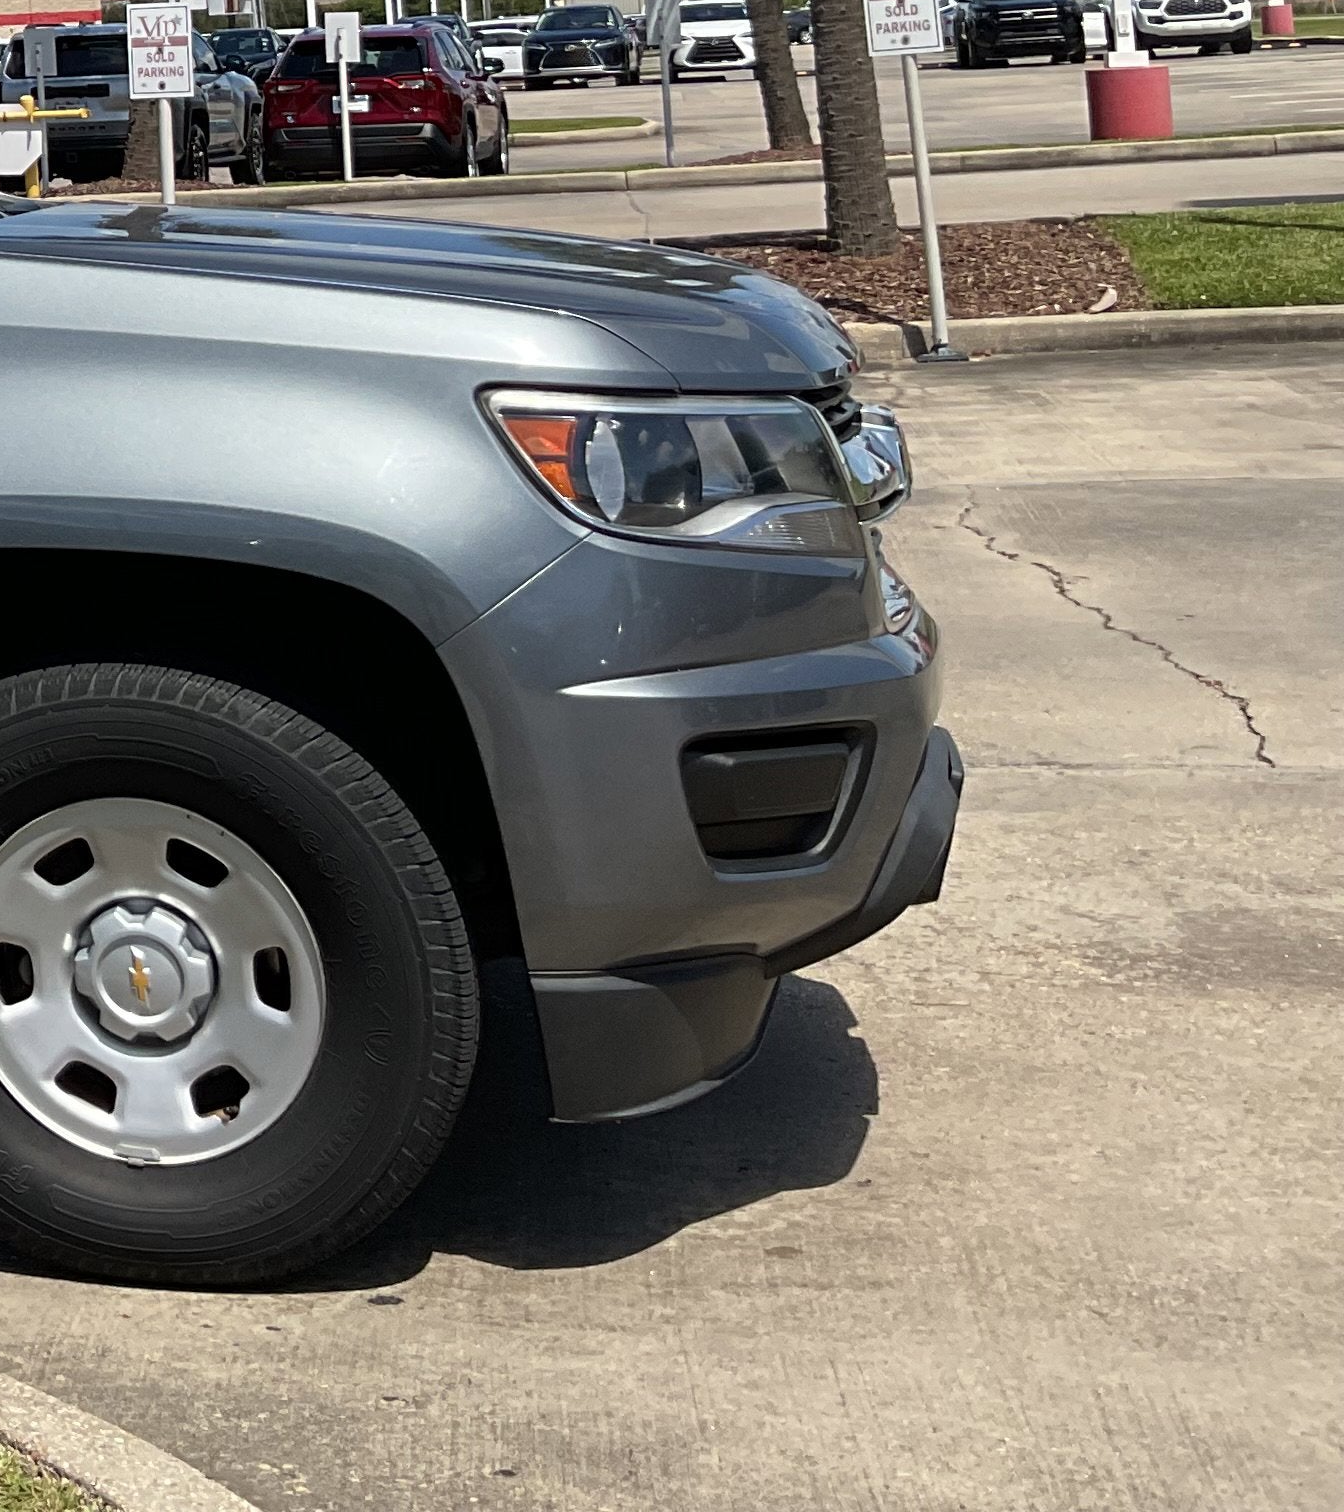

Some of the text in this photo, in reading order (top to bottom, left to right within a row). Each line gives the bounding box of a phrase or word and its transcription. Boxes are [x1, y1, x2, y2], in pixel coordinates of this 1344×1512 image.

[885, 4, 918, 18] SOLD
[875, 19, 931, 35] PARKING
[146, 51, 175, 63] SOLD
[137, 65, 185, 79] PARKING
[234, 772, 390, 989] Firestone
